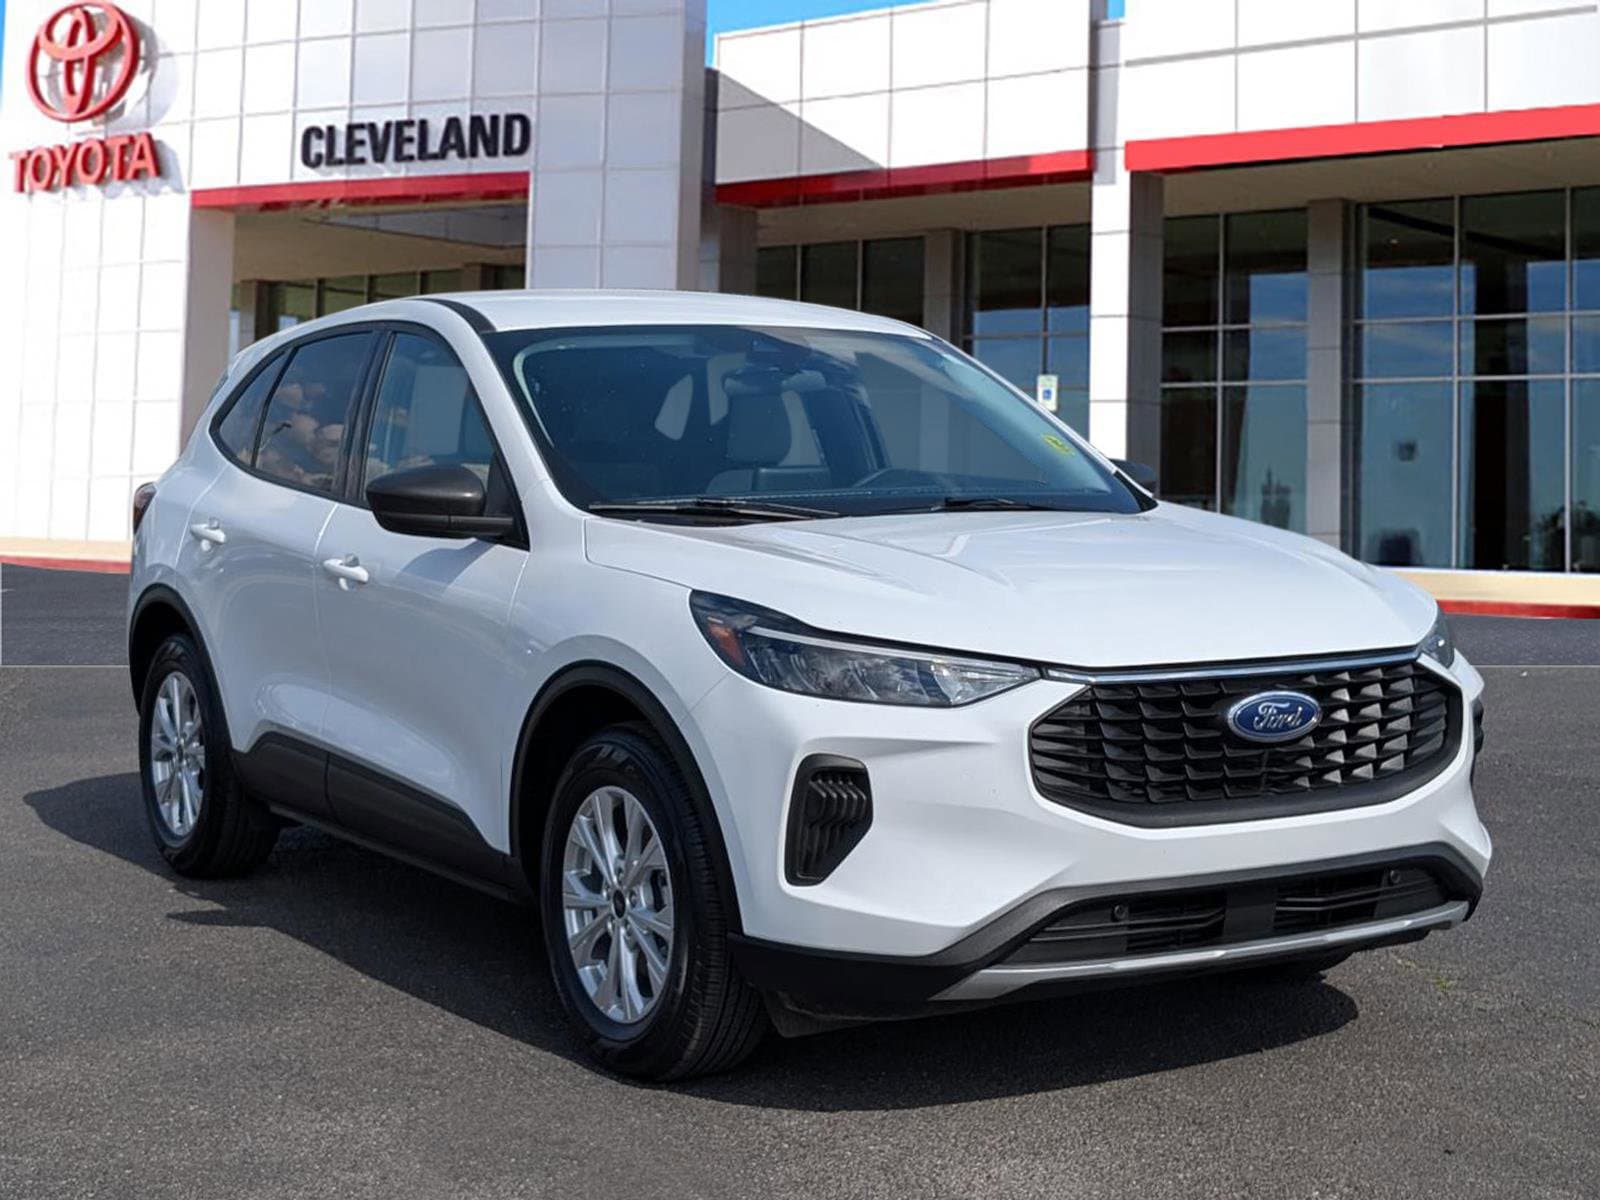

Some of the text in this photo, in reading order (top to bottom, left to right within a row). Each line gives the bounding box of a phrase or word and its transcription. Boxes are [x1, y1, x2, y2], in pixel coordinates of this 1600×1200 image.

[9, 132, 161, 193] TOYOTA
[300, 113, 531, 169] CLEVELAND
[1253, 702, 1302, 730] Ford
